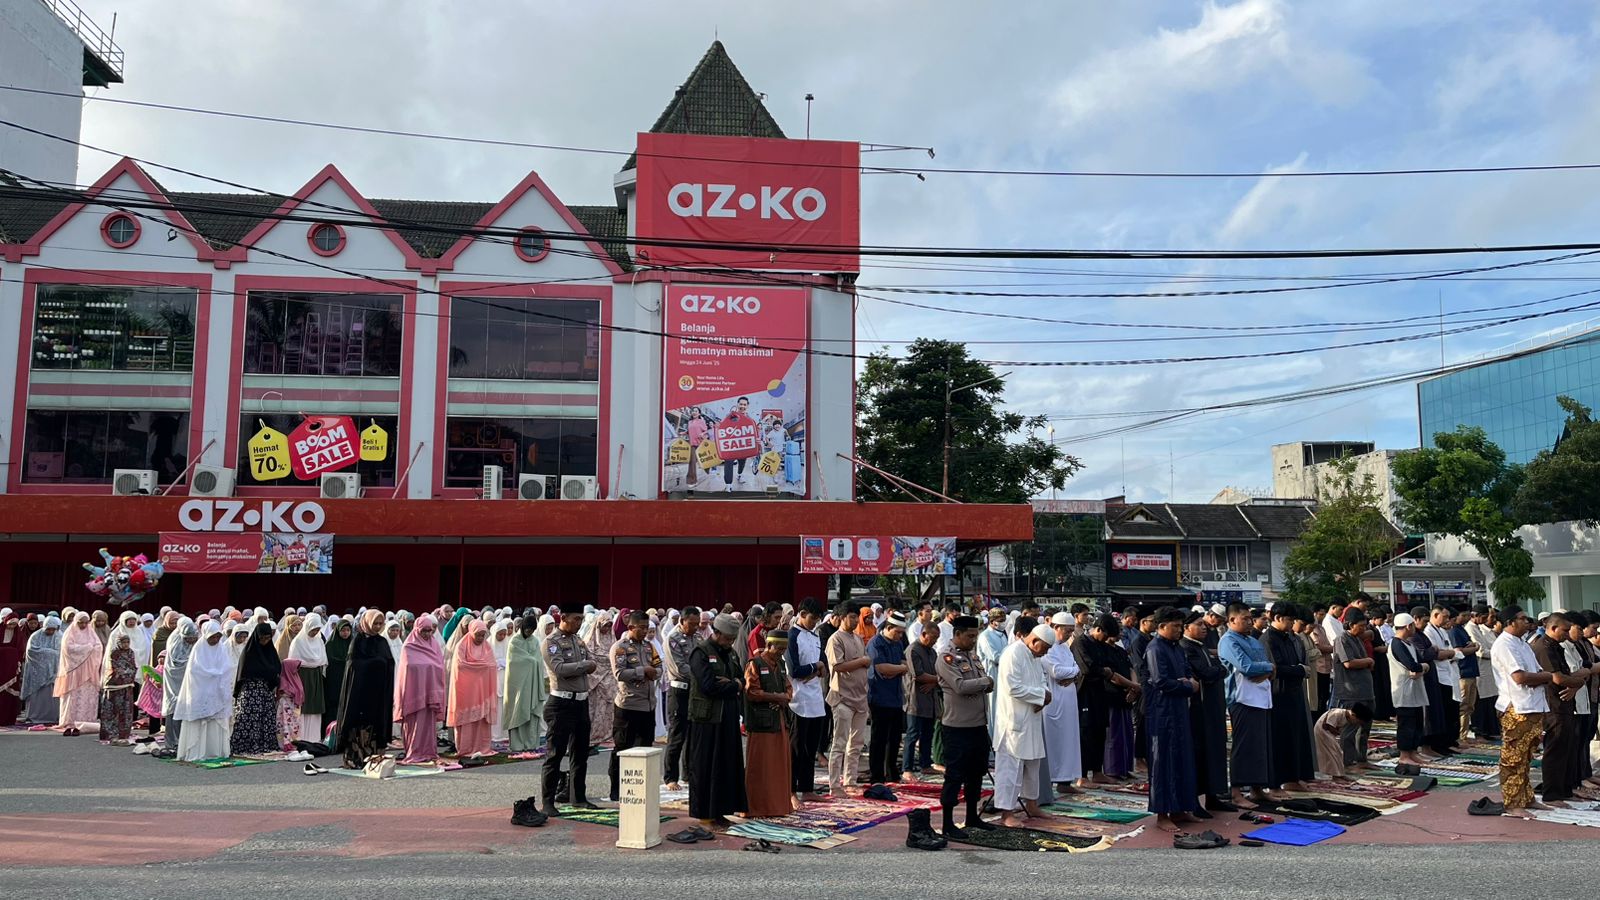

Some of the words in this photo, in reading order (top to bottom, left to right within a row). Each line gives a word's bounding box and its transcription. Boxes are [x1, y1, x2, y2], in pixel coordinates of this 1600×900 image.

[680, 322, 716, 334] Belanja
[680, 346, 727, 357] hematnya
[728, 347, 774, 357] maksimal
[253, 444, 280, 454] Hemat
[723, 439, 753, 450] SALE
[303, 442, 352, 471] SALE
